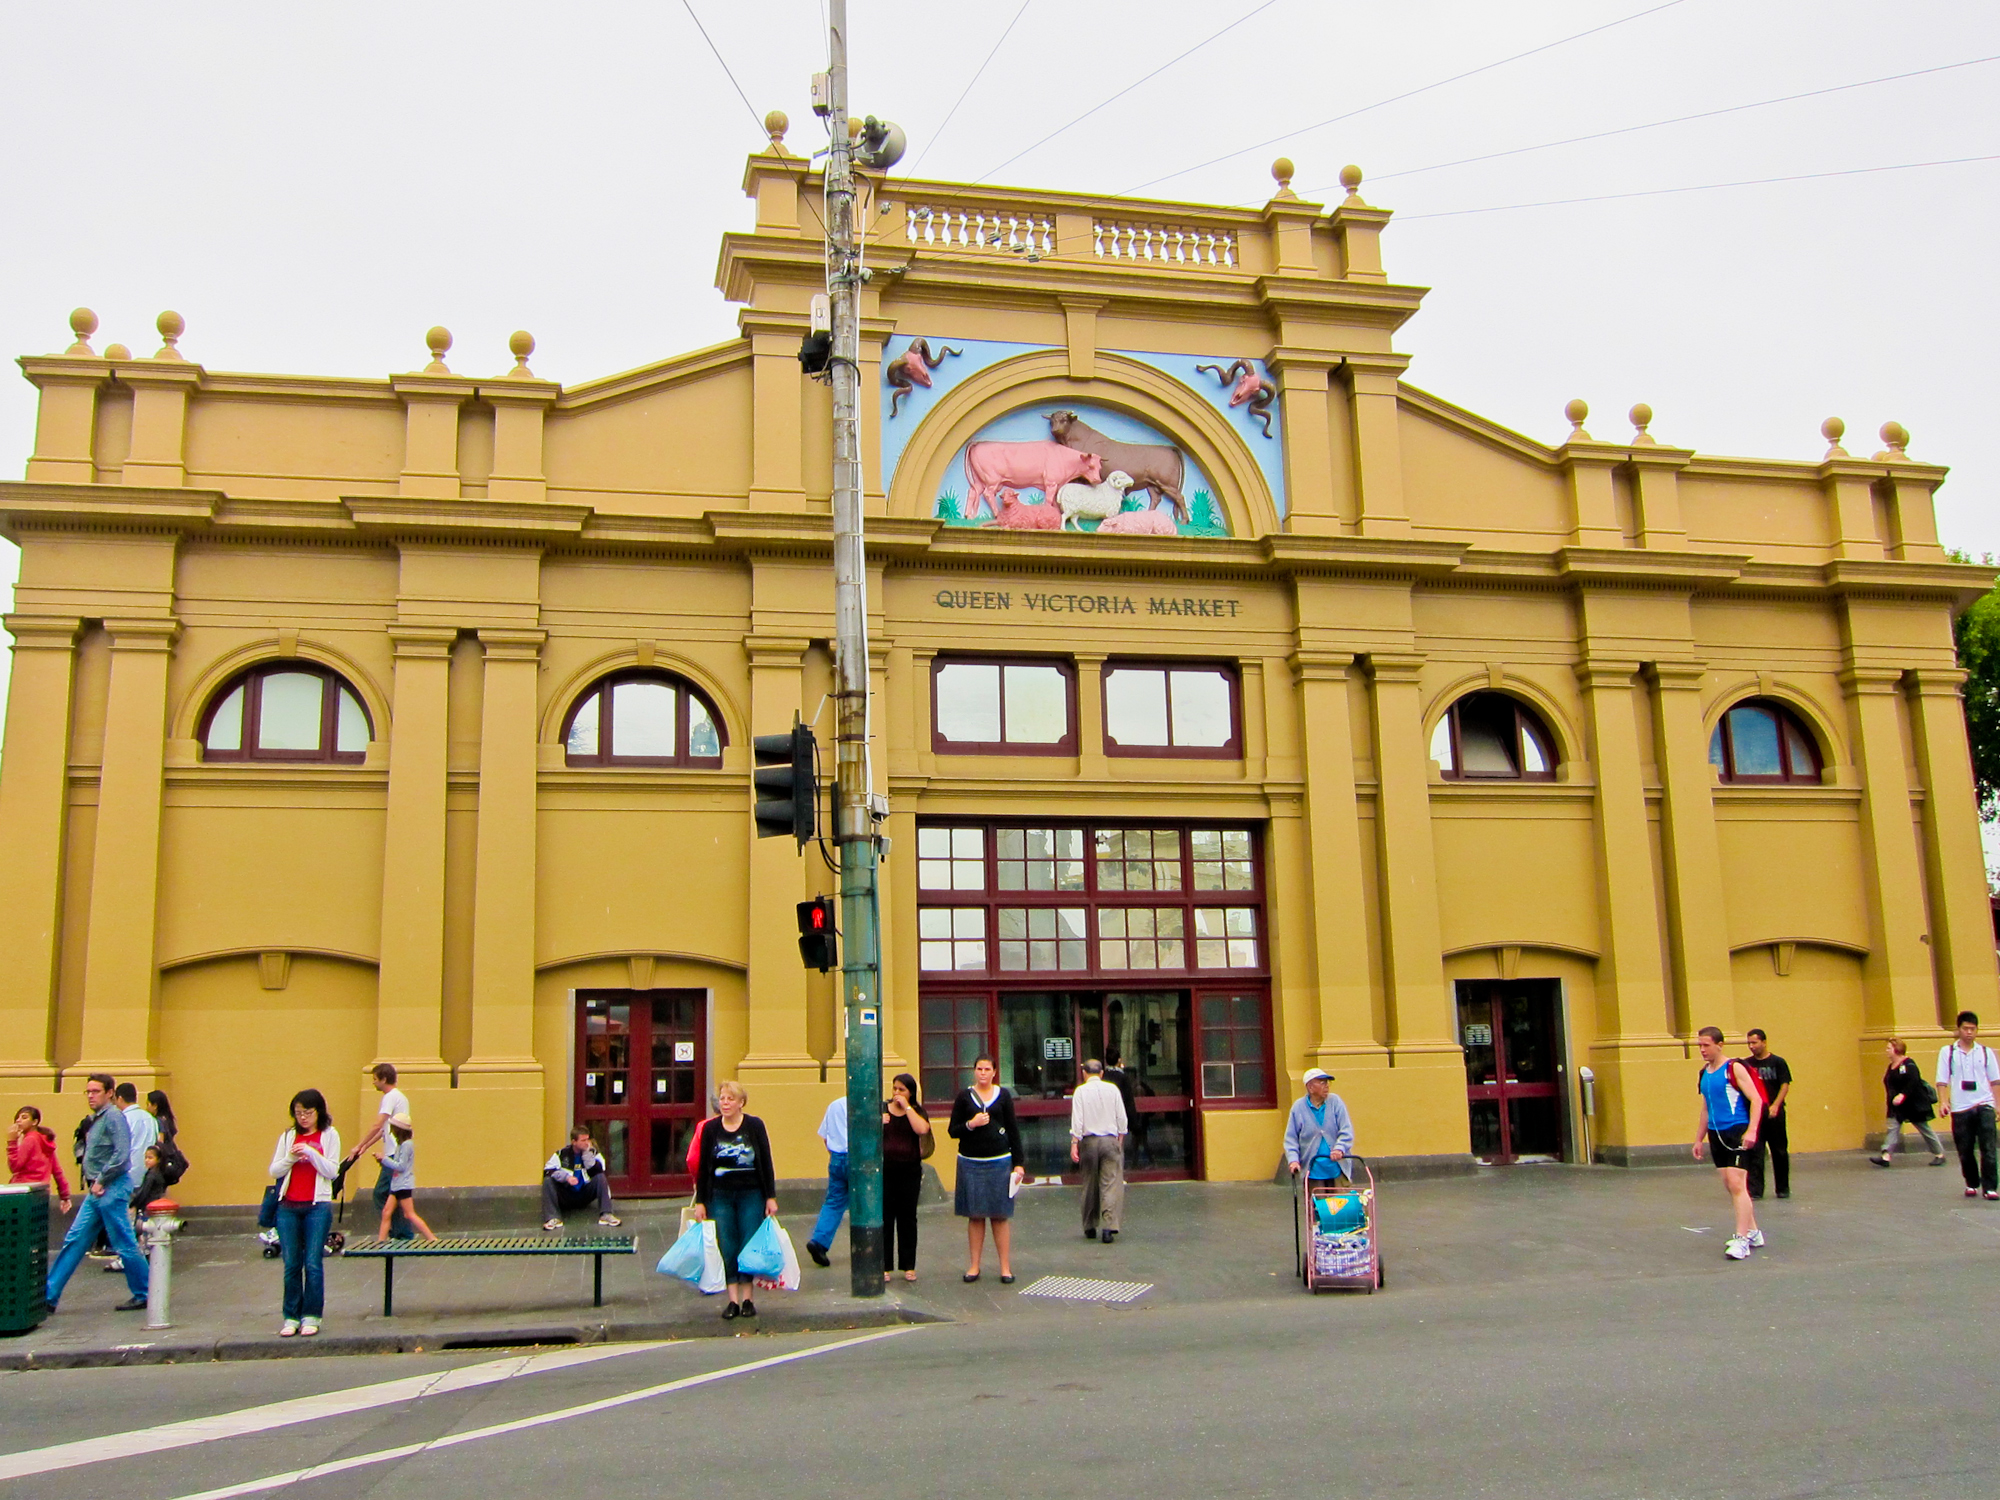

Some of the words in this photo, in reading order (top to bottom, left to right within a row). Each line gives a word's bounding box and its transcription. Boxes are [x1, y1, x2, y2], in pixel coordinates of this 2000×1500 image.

[936, 590, 1011, 610] QUEEN
[1024, 593, 1136, 614] VICTORIA
[1149, 597, 1240, 617] MARKET
